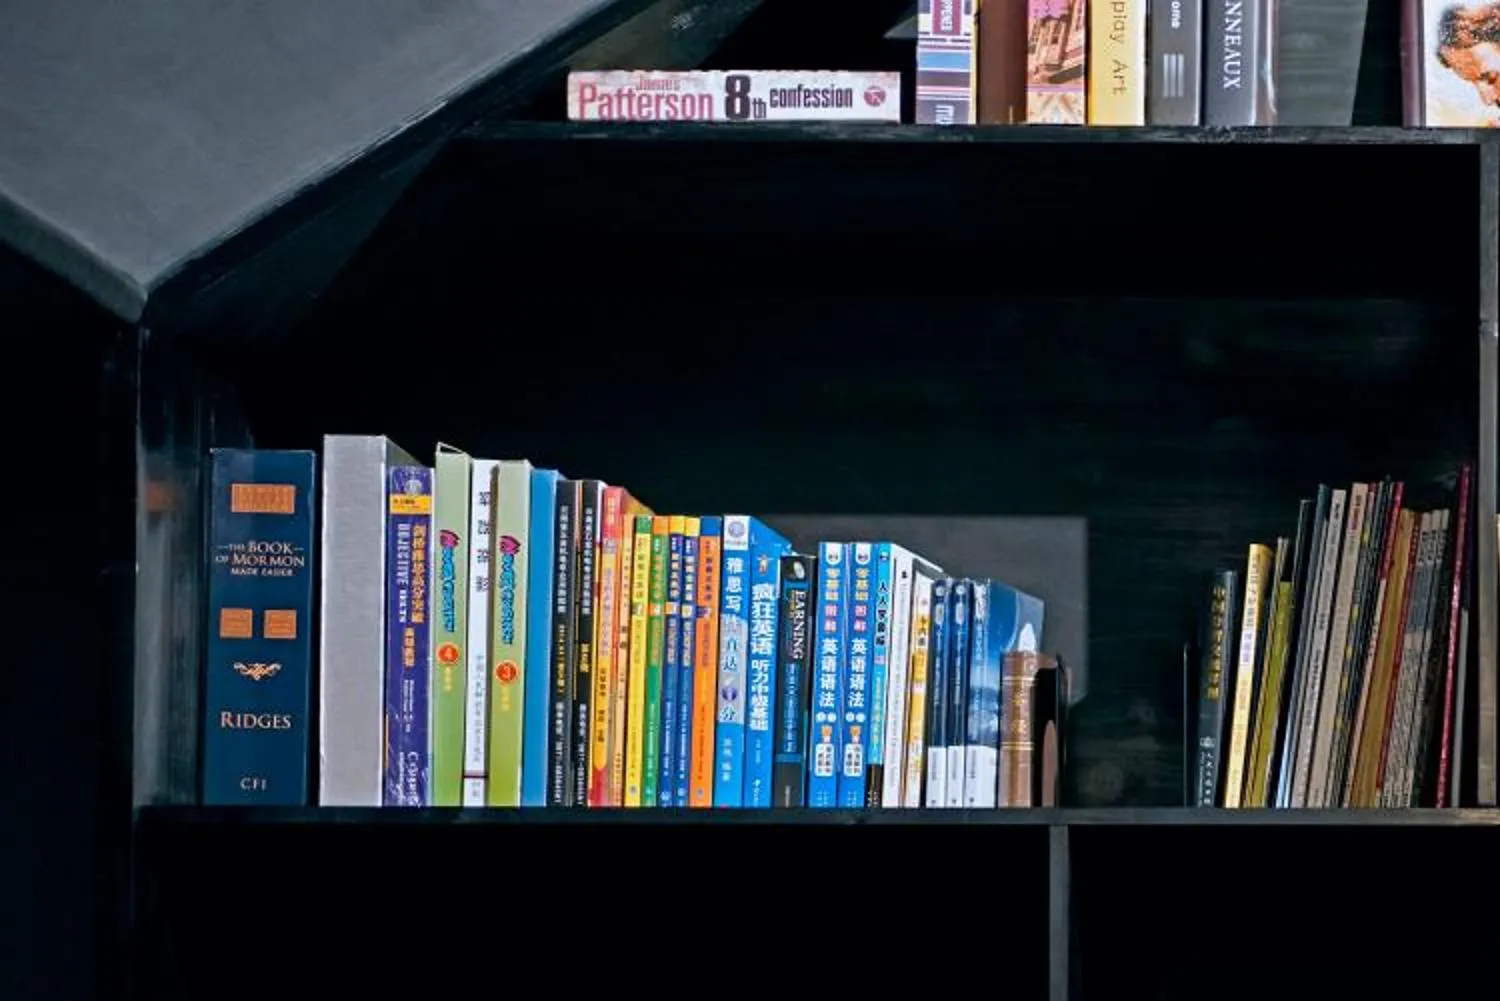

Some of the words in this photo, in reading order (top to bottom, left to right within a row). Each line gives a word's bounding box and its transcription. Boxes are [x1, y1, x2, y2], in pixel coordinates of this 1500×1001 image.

[1112, 59, 1128, 95] Art
[577, 79, 714, 121] Patterson
[769, 84, 853, 109] confession
[248, 540, 293, 554] BOOK
[231, 553, 305, 568] MORMON
